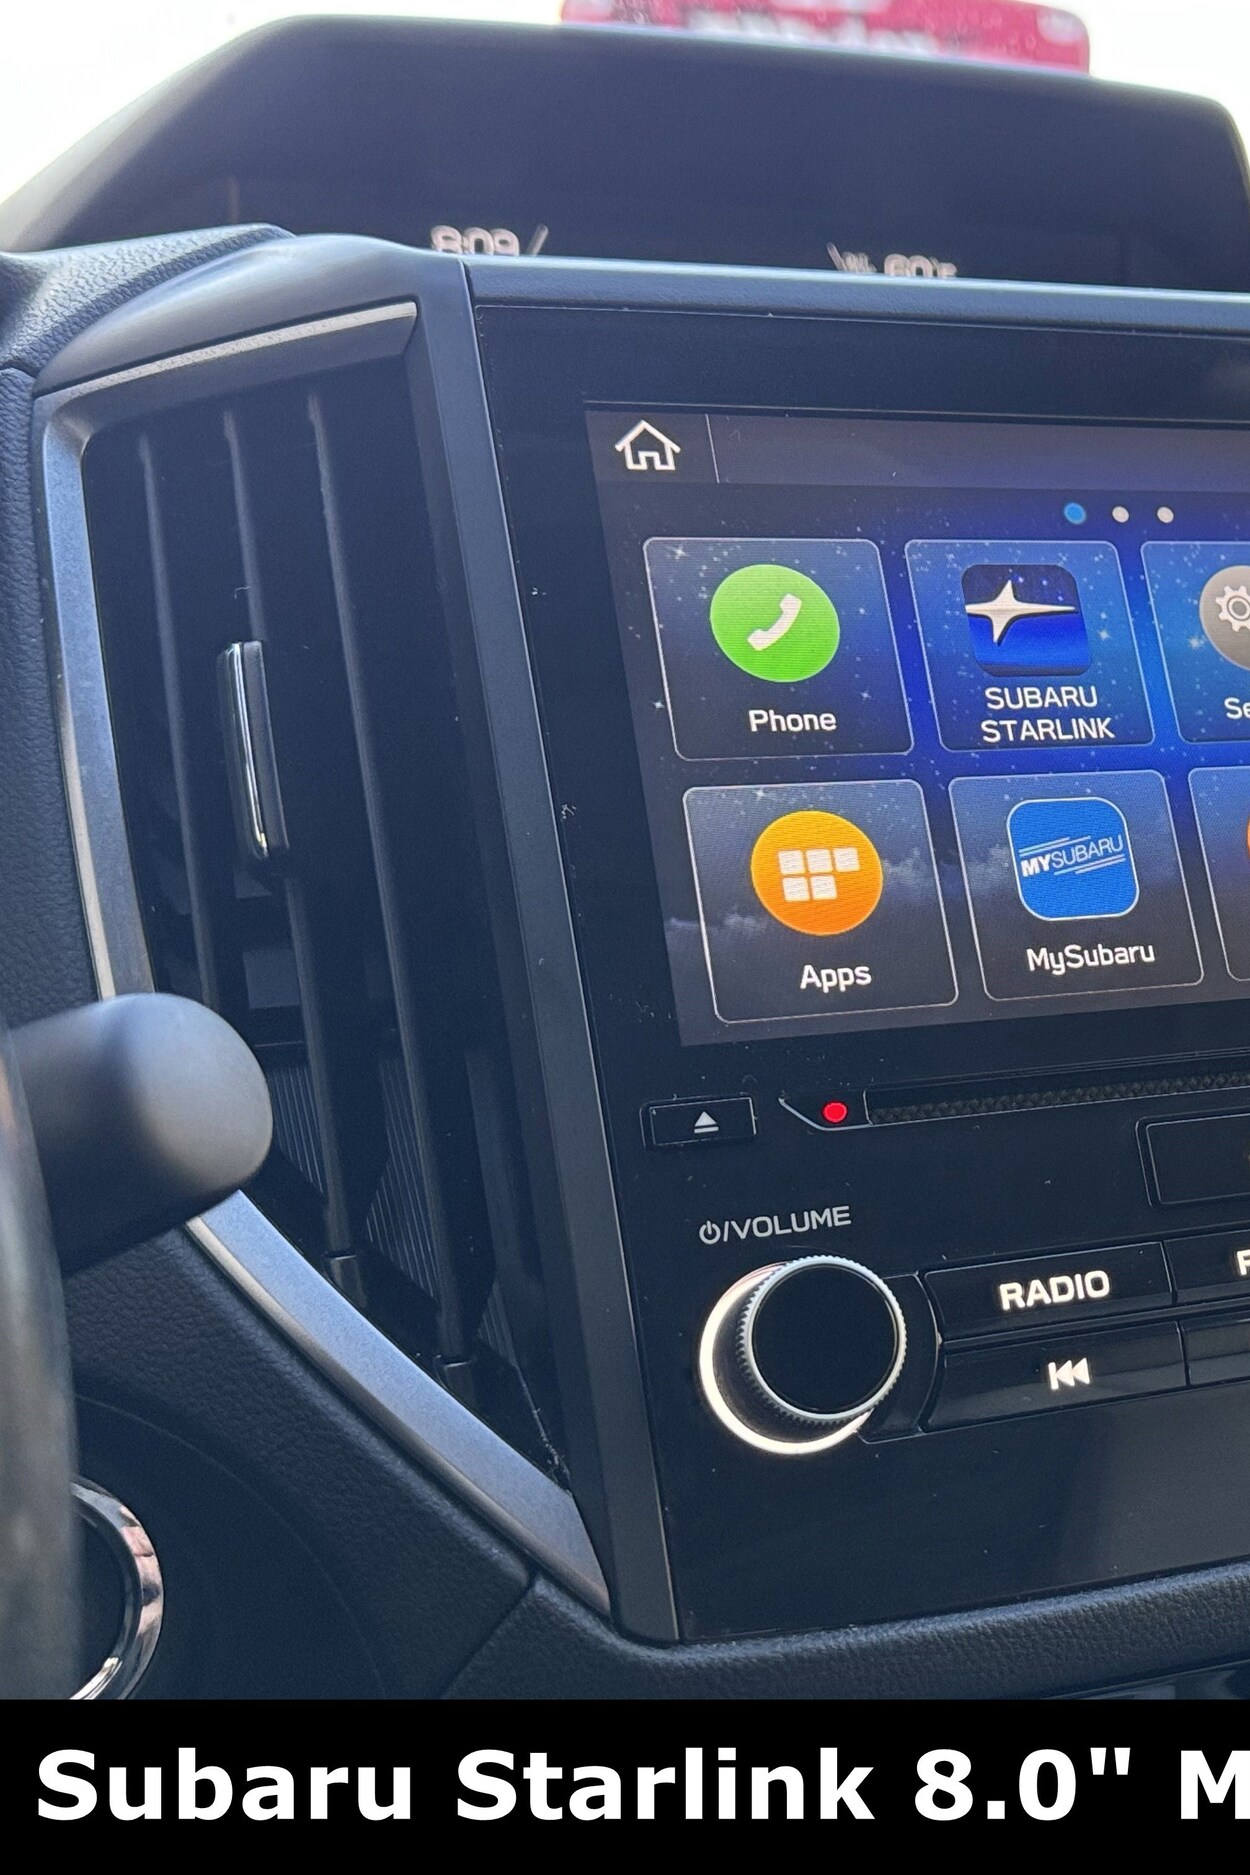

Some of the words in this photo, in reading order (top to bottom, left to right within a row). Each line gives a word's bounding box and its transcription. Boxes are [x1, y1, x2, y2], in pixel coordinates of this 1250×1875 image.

[984, 686, 1099, 710] SUBARU
[748, 709, 837, 733] Phone
[981, 717, 1115, 743] STARLINK
[1026, 942, 1156, 975] MySubaru
[800, 964, 872, 993] Apps
[999, 1270, 1111, 1310] RADIO
